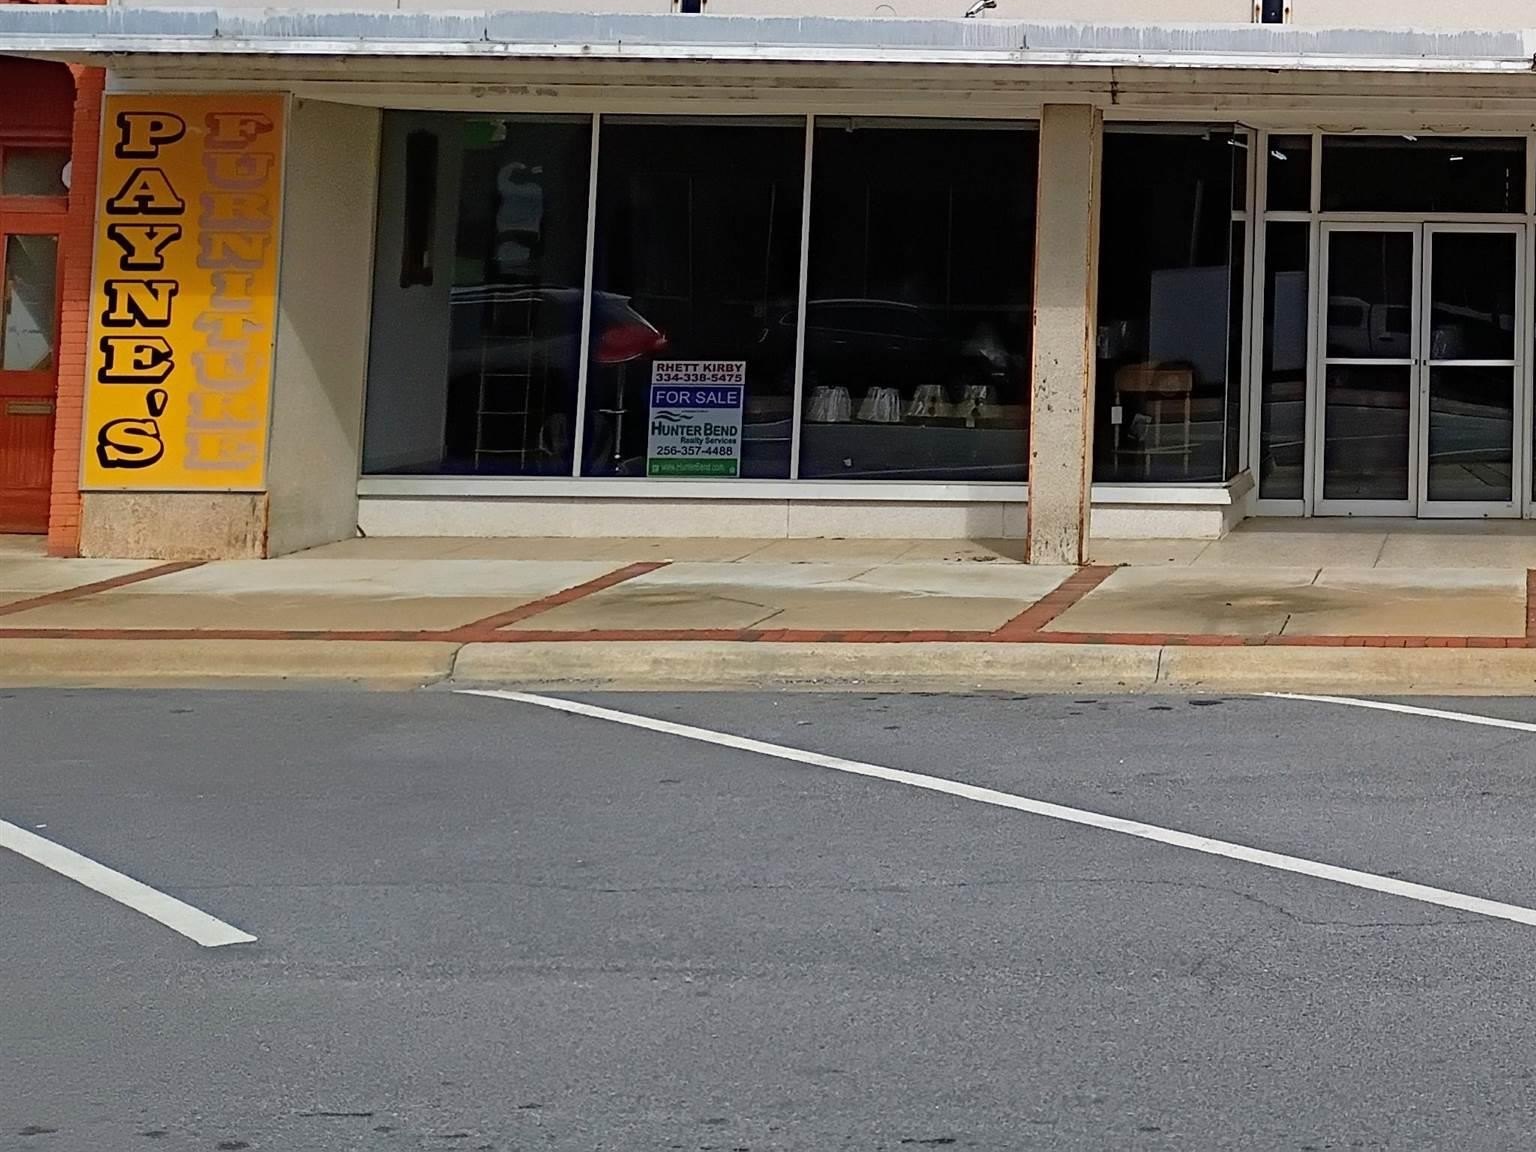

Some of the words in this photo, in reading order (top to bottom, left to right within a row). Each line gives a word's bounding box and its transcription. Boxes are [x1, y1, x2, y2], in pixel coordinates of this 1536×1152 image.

[96, 111, 186, 469] PAYNE'S
[656, 363, 699, 373] RHETT
[703, 363, 743, 373] KIRBY
[655, 373, 742, 382] 334-338-5475
[655, 391, 690, 404] FOR
[695, 391, 738, 404] SALE
[680, 437, 704, 445] Realty
[656, 446, 733, 456] 256-357-4488
